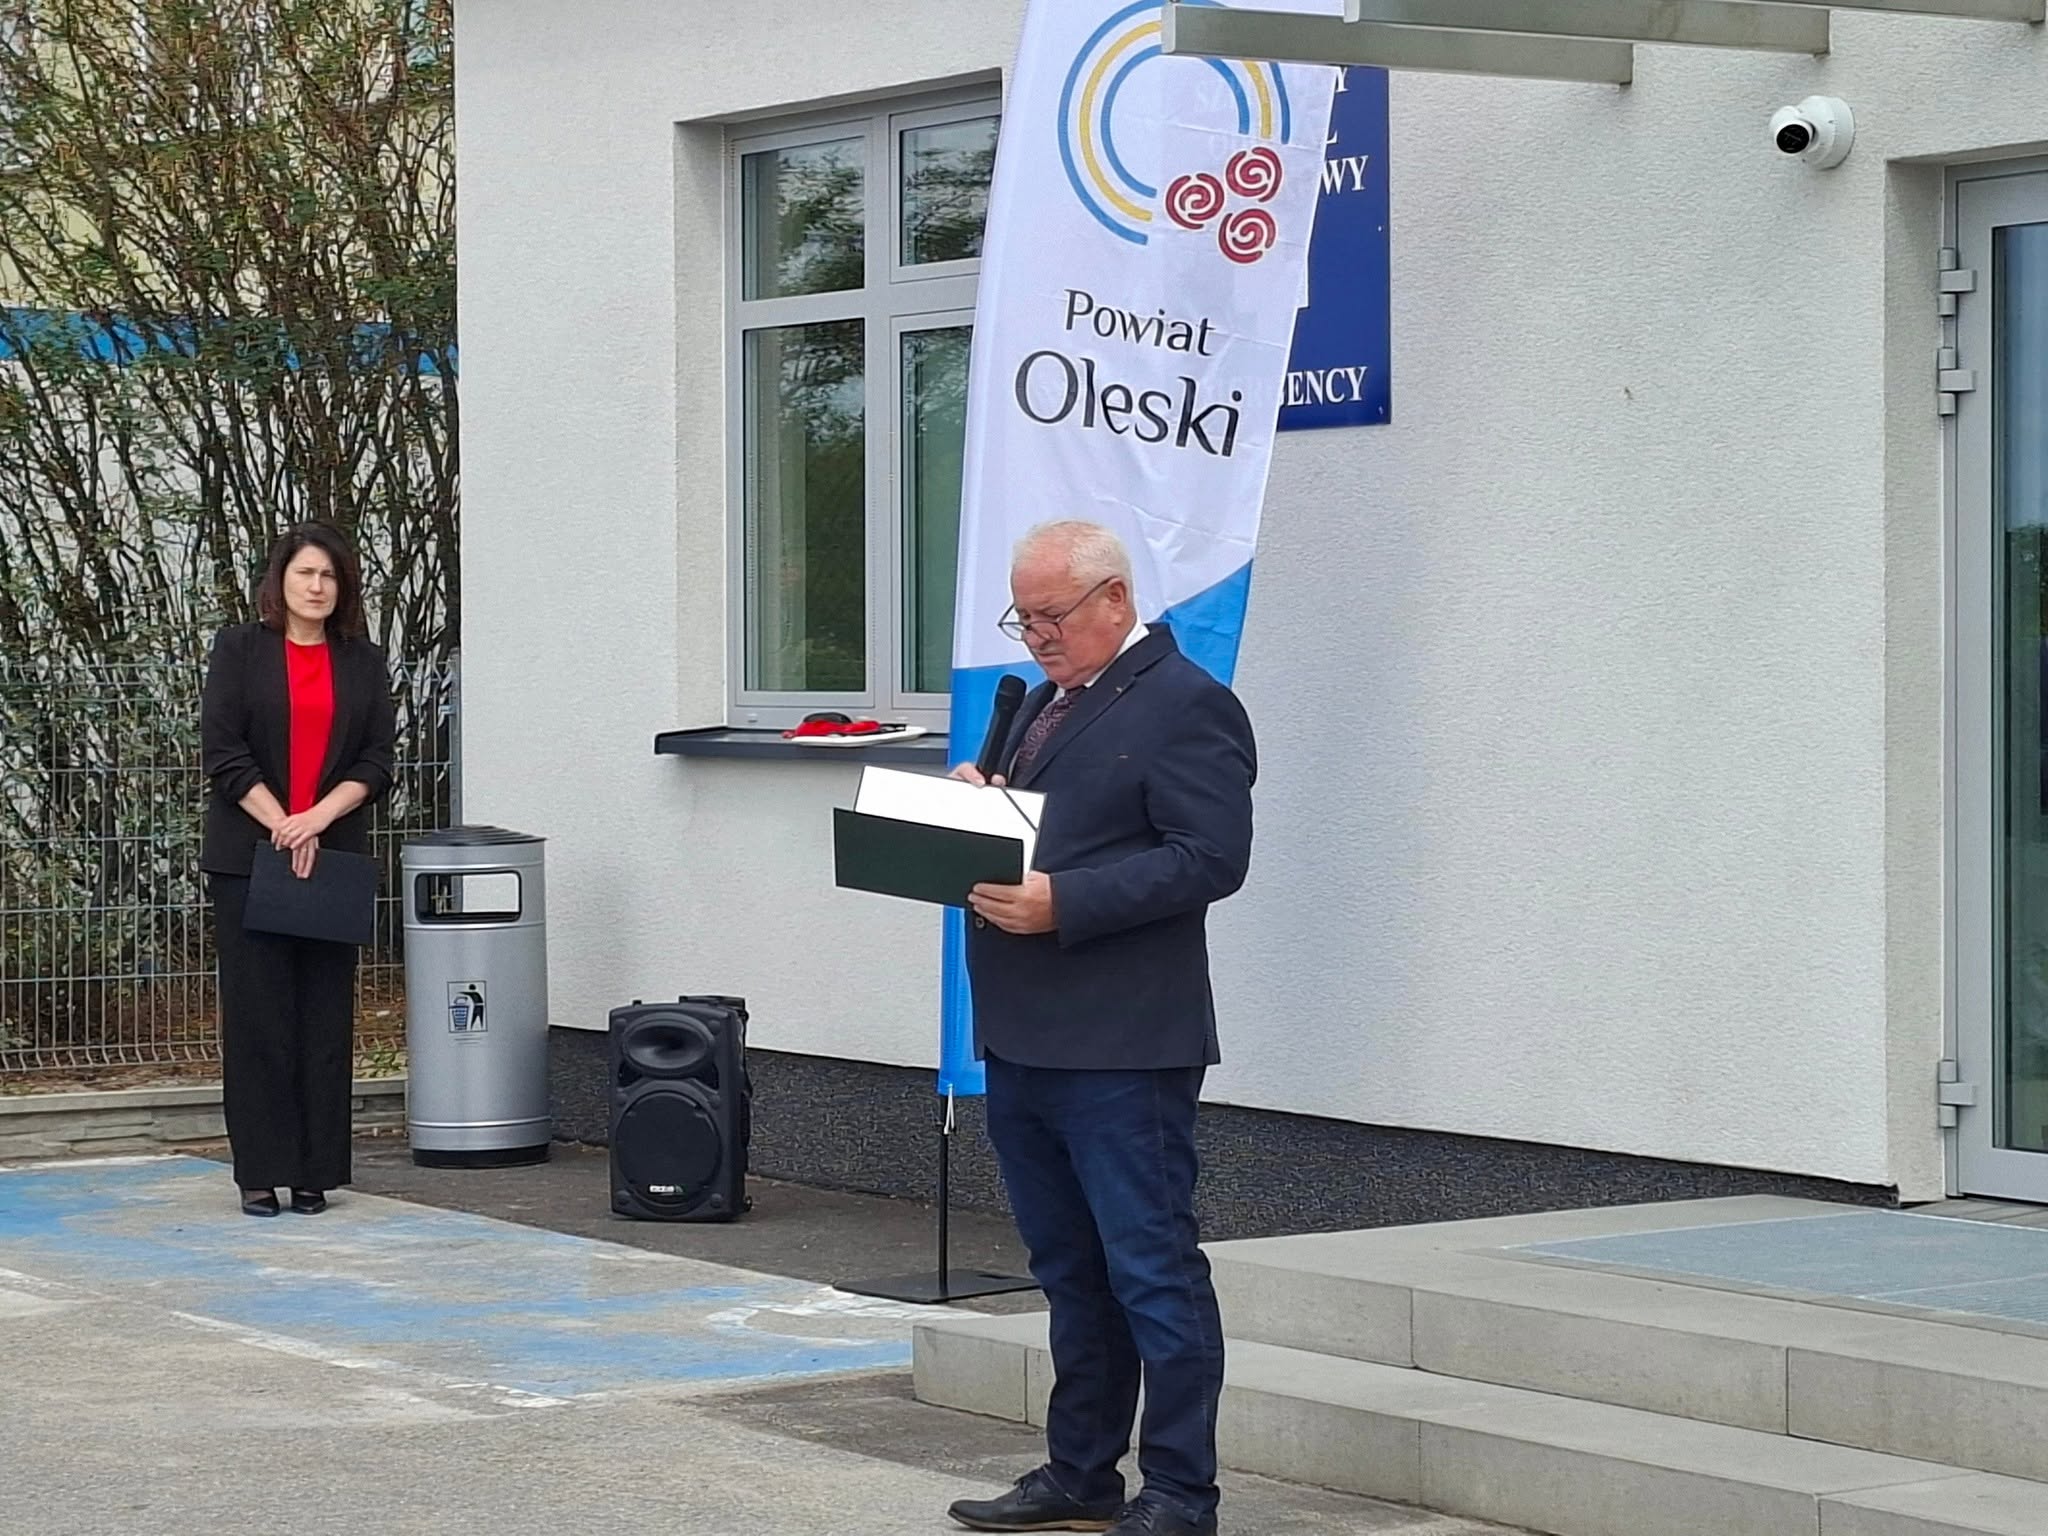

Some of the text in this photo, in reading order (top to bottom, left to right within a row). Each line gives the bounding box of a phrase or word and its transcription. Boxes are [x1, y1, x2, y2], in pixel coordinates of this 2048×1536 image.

[1064, 289, 1216, 356] Powiat
[1015, 350, 1242, 457] Oleski
[1281, 366, 1368, 406] ENCY
